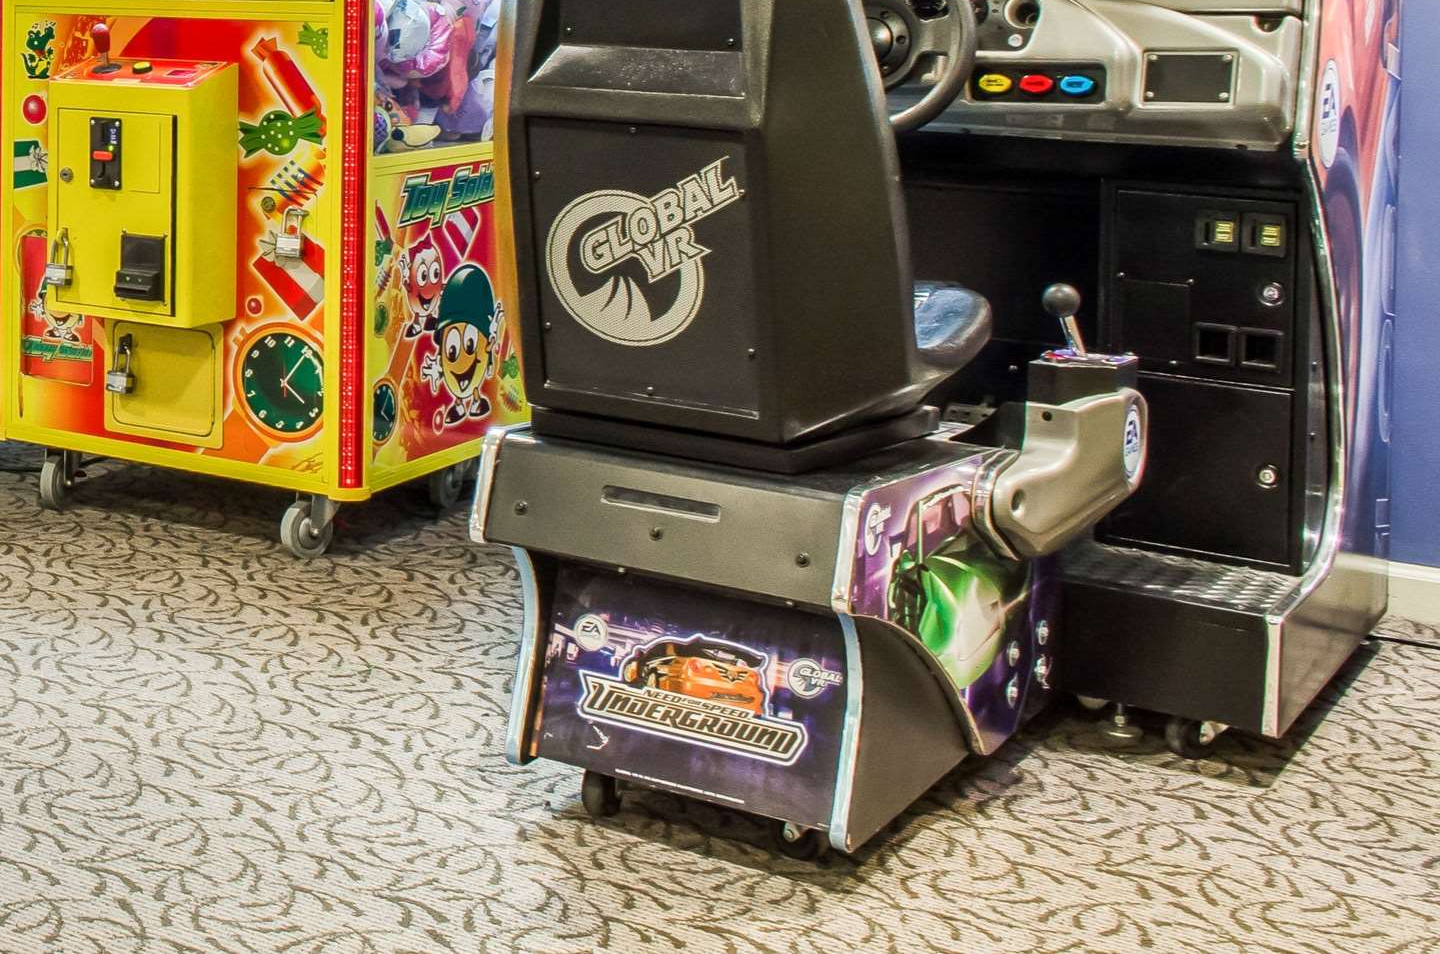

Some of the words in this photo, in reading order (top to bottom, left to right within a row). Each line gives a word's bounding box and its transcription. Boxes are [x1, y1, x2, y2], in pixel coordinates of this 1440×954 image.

[398, 172, 451, 230] Toy
[580, 158, 741, 273] GLOBAL
[635, 224, 712, 284] VR
[264, 336, 277, 348] 10
[284, 336, 296, 348] 11
[250, 349, 260, 358] 9
[245, 368, 254, 378] 8
[246, 389, 256, 398] 7
[258, 409, 267, 419] 6
[580, 621, 601, 636] EA
[799, 667, 843, 683] GLOBAL
[811, 677, 826, 687] VR
[642, 688, 683, 705] NEED
[681, 697, 702, 707] FOR
[701, 700, 754, 720] SPEED
[587, 681, 800, 755] UNDERGROUND
